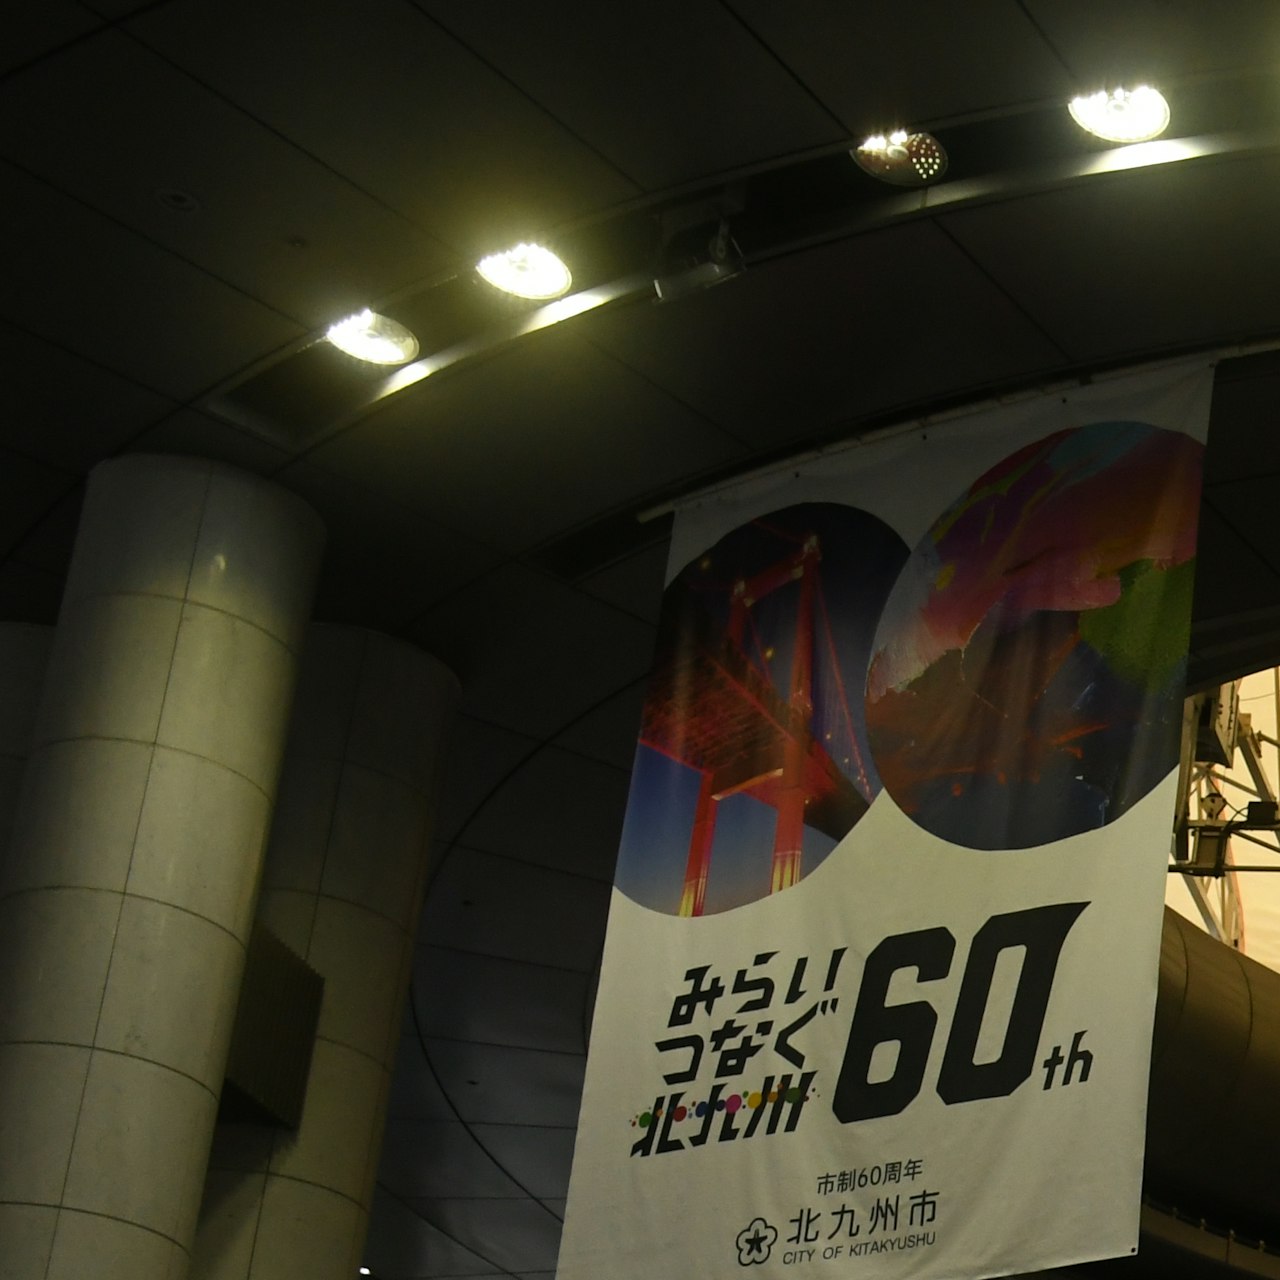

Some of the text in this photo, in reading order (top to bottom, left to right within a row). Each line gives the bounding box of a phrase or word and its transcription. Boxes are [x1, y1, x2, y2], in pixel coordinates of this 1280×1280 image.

[668, 946, 848, 1028] みらい
[832, 901, 1094, 1124] 60th
[655, 1000, 840, 1087] つなぐ
[630, 1070, 818, 1157] 北九州
[786, 1190, 940, 1245] 北九州市
[817, 1159, 923, 1195] 市制60周年
[783, 1232, 936, 1265] CITY OF KITAKYUSHU
